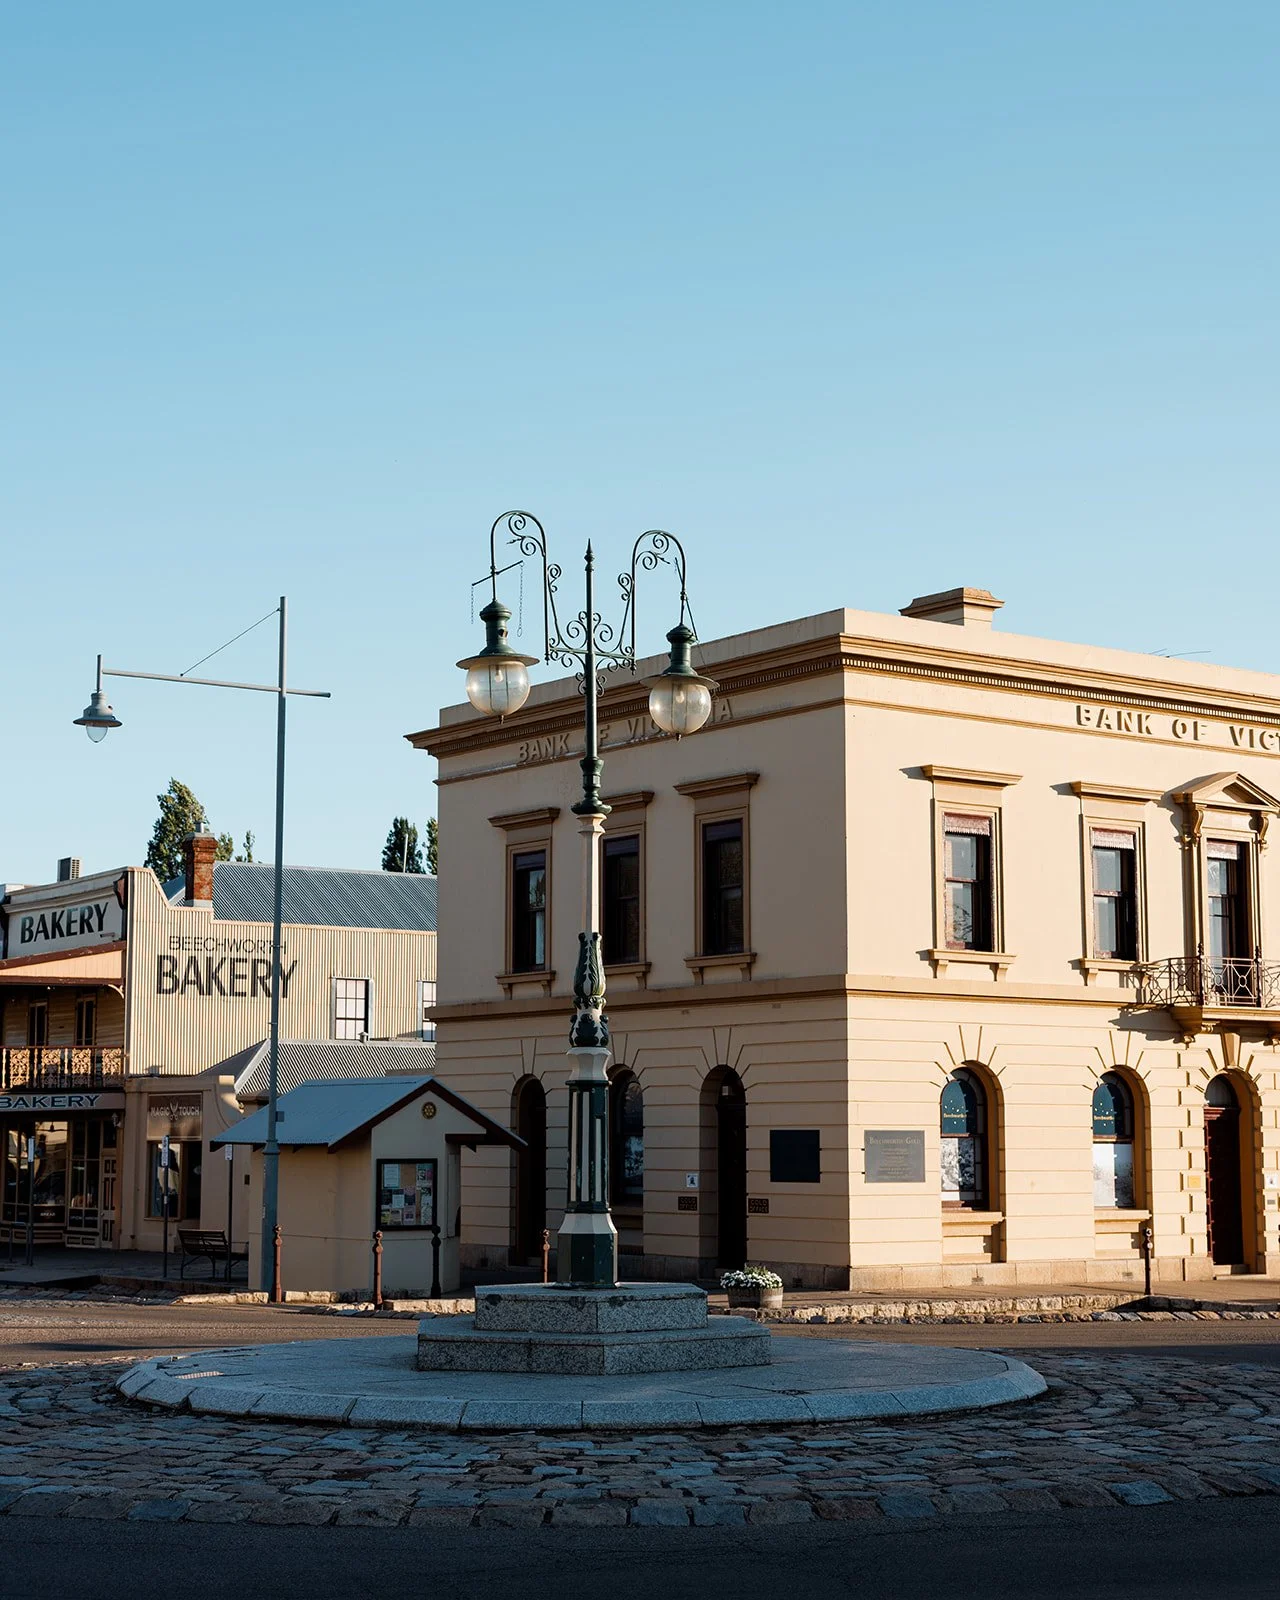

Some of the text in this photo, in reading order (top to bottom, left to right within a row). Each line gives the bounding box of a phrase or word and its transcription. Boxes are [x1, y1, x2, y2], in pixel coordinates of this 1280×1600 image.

[1075, 704, 1153, 736] BANK
[1171, 718, 1209, 741] OF
[518, 733, 571, 763] BANK
[20, 901, 109, 944] BAKERY
[169, 935, 287, 955] BEECHWORTH
[156, 953, 298, 999] BAKERY
[0, 1094, 102, 1109] BAKERY
[178, 1106, 200, 1117] TOUCH
